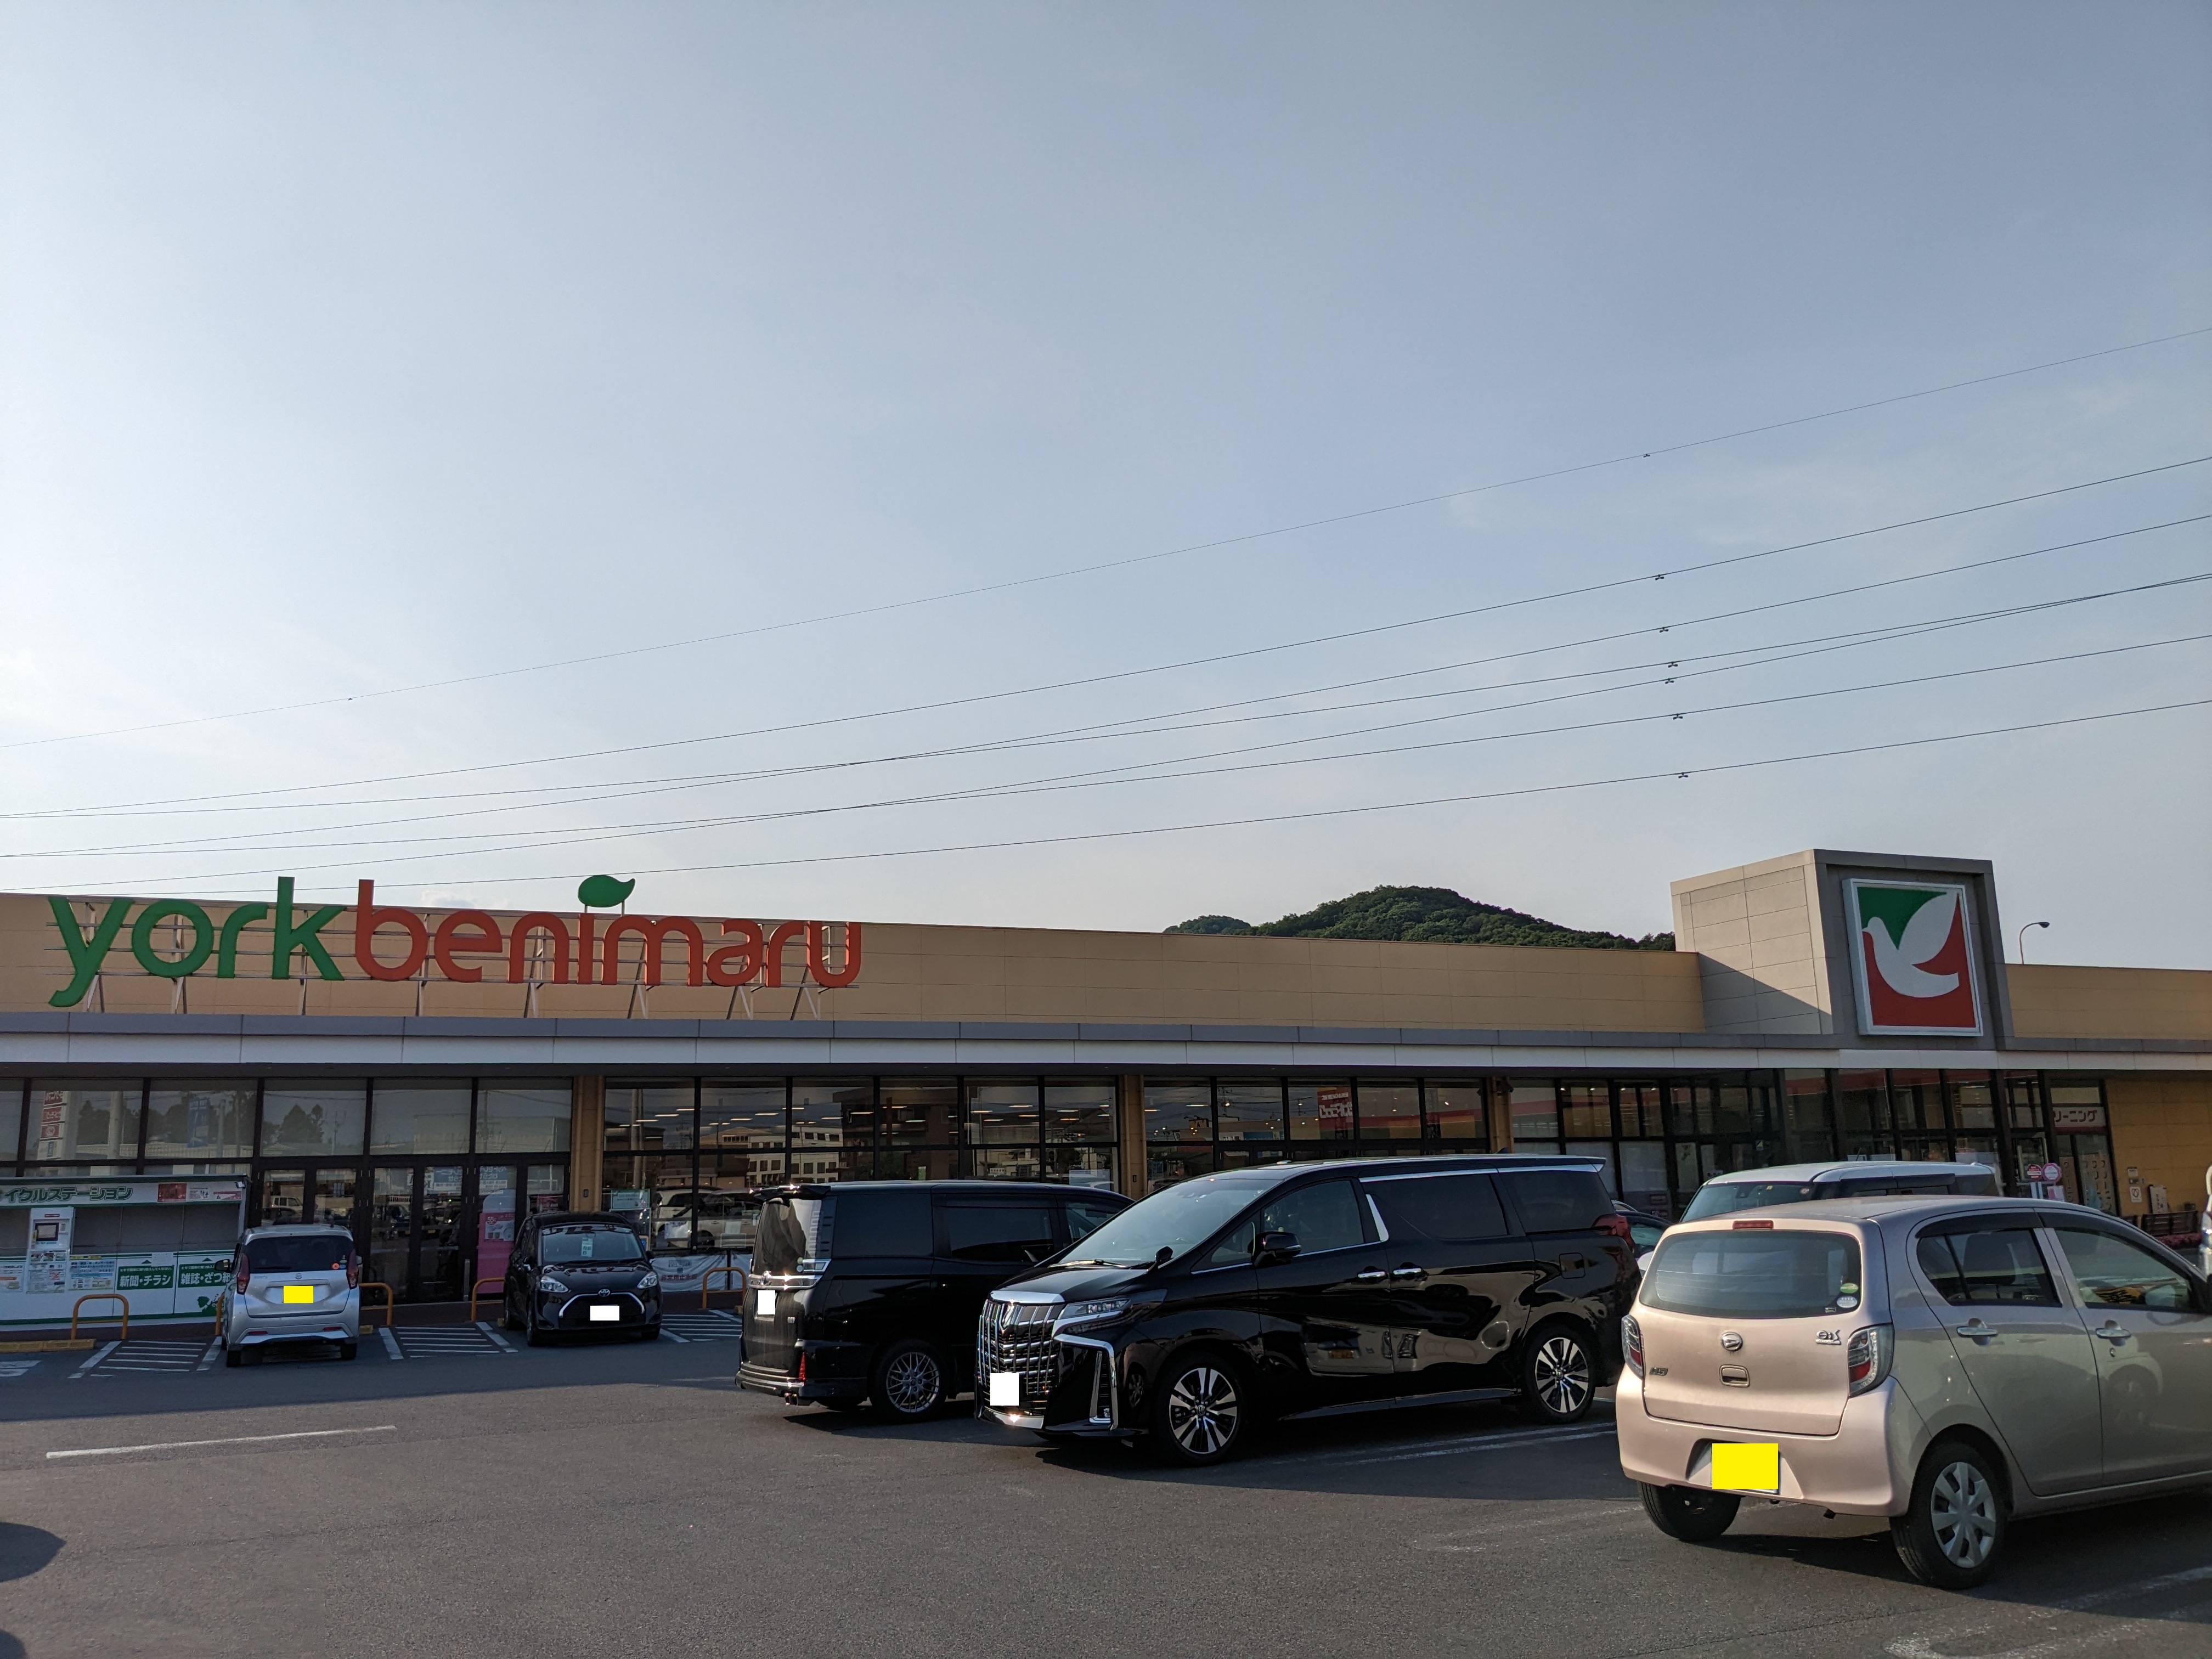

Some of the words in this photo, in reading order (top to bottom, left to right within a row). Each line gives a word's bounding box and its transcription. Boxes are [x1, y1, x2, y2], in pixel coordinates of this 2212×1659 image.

[2053, 1110, 2097, 1122] リーニング
[0, 1187, 133, 1204] イクルステーション
[119, 1274, 171, 1288] 新聞・チラシ
